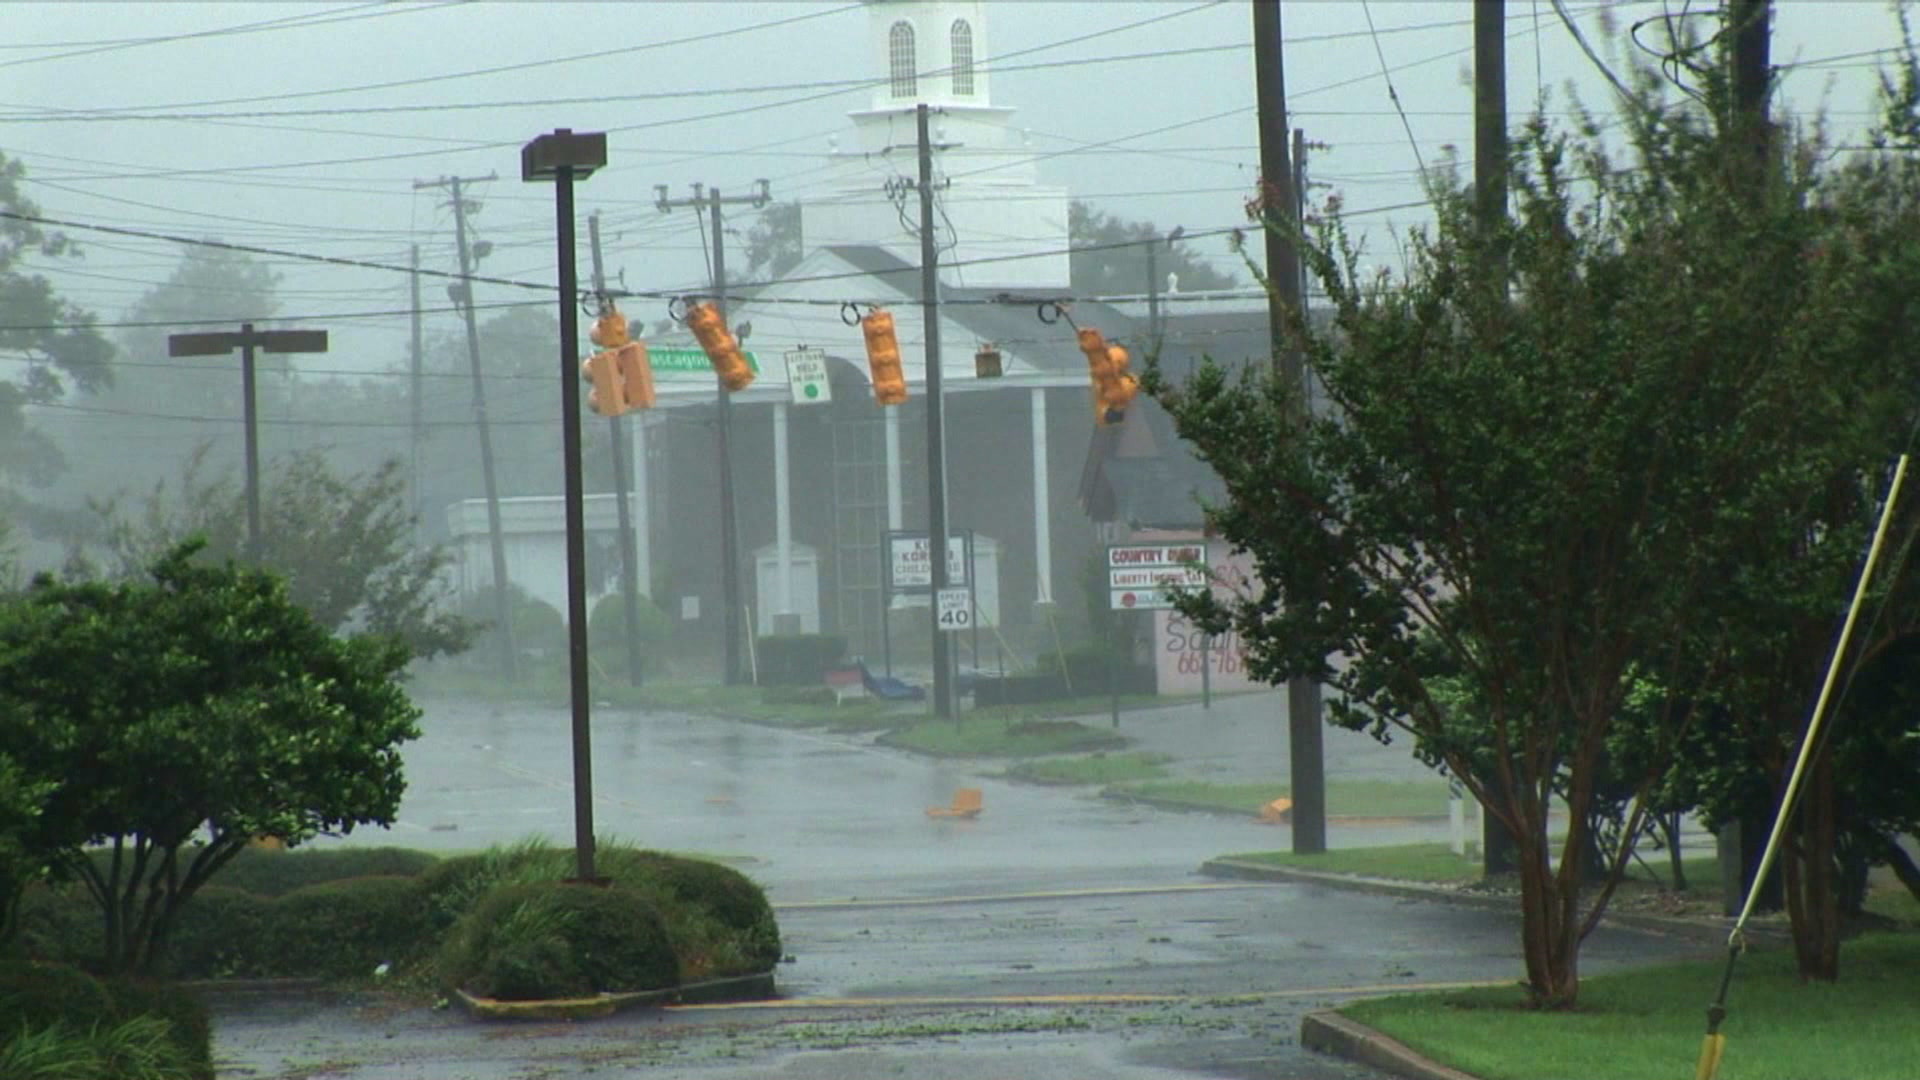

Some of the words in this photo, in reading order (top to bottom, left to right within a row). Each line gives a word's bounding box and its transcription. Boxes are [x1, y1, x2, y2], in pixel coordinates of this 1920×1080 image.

[1112, 548, 1162, 564] COUNTRY
[940, 591, 967, 600] SPEED
[943, 601, 965, 609] LIMIT
[940, 609, 969, 625] 40
